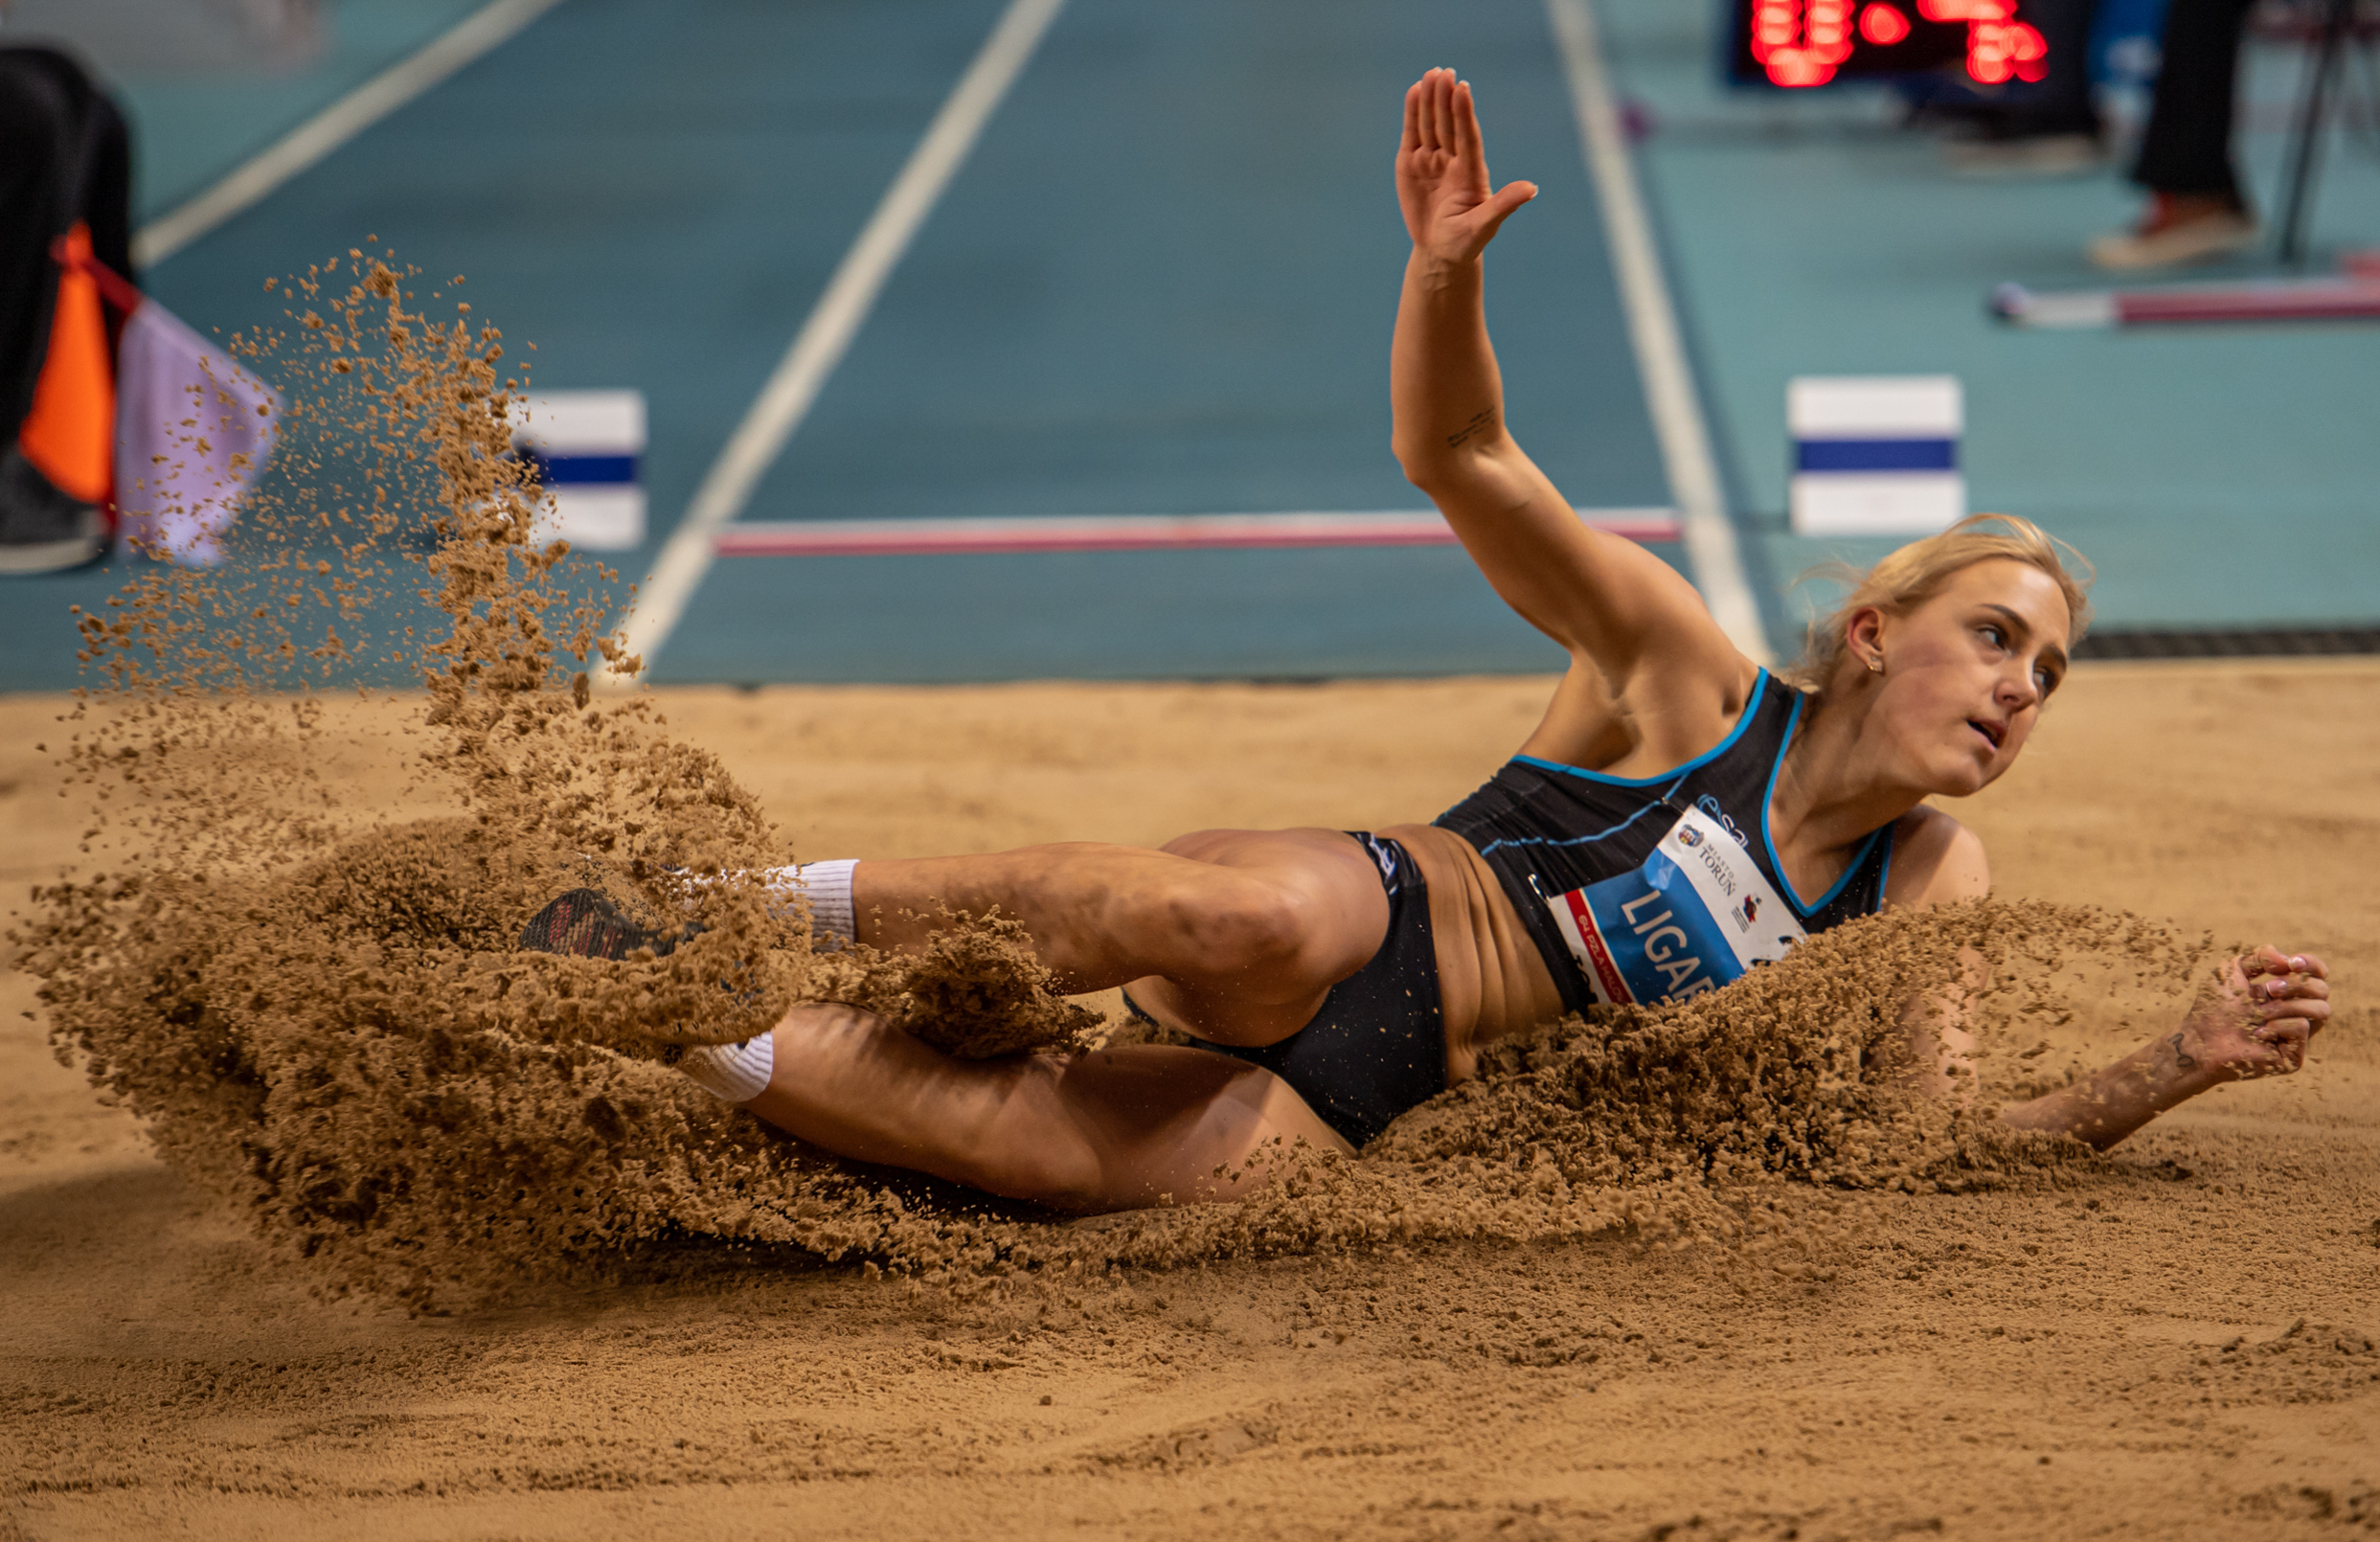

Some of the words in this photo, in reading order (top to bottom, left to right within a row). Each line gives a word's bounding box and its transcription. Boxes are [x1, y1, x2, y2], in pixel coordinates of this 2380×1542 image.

[1699, 847, 1736, 896] TORUŃ
[1708, 844, 1734, 879] MIASTO
[1586, 934, 1605, 966] PZLA
